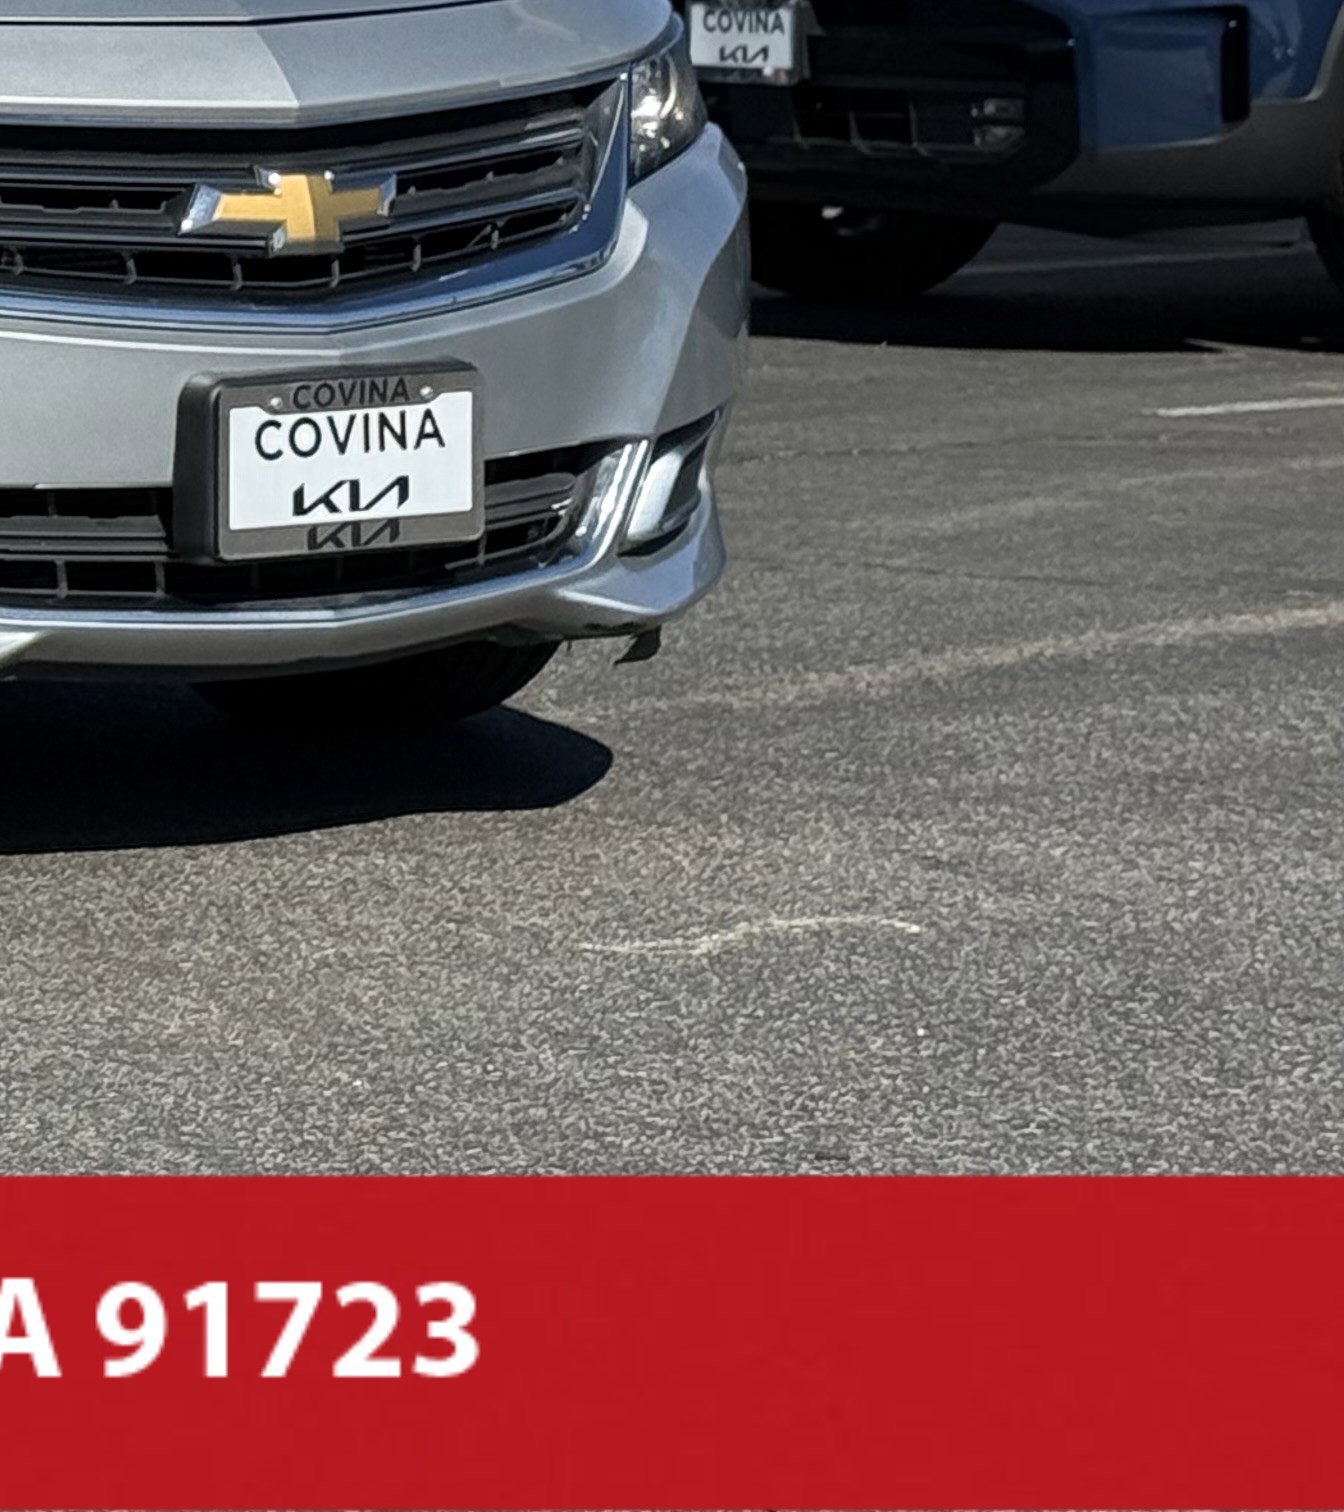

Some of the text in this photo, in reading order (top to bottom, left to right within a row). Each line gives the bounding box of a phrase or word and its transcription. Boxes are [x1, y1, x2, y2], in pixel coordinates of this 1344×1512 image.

[703, 8, 785, 35] COVINA
[719, 44, 769, 64] KIA
[293, 377, 411, 410] COVINA
[255, 408, 446, 461] COVINA
[292, 475, 409, 517] KIA
[307, 519, 401, 551] KIA
